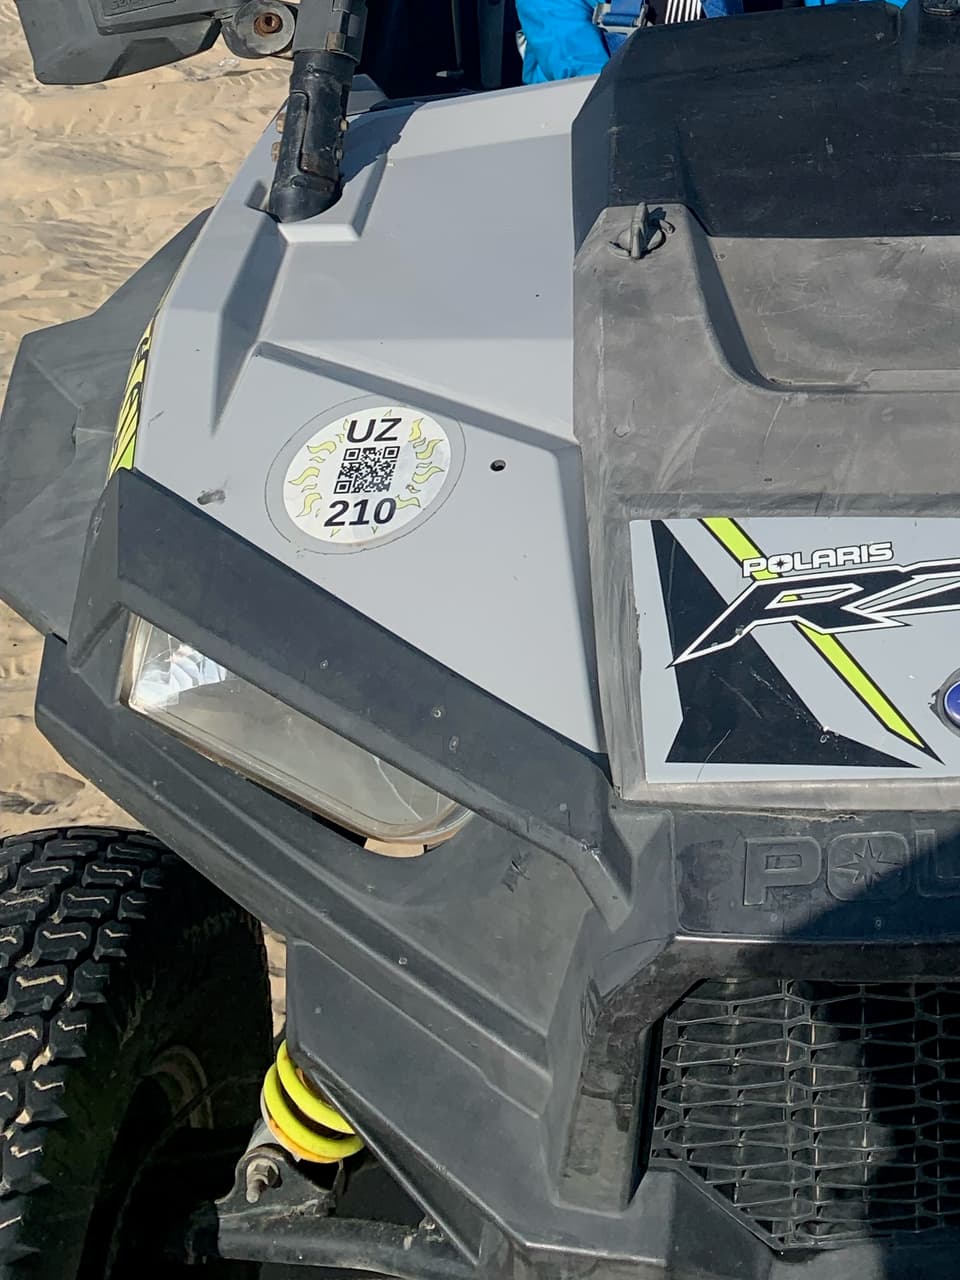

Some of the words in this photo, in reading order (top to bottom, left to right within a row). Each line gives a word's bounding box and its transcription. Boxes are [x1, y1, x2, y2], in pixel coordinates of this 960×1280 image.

[347, 418, 402, 443] UZ
[324, 497, 397, 527] 210
[742, 541, 894, 578] POLARIS
